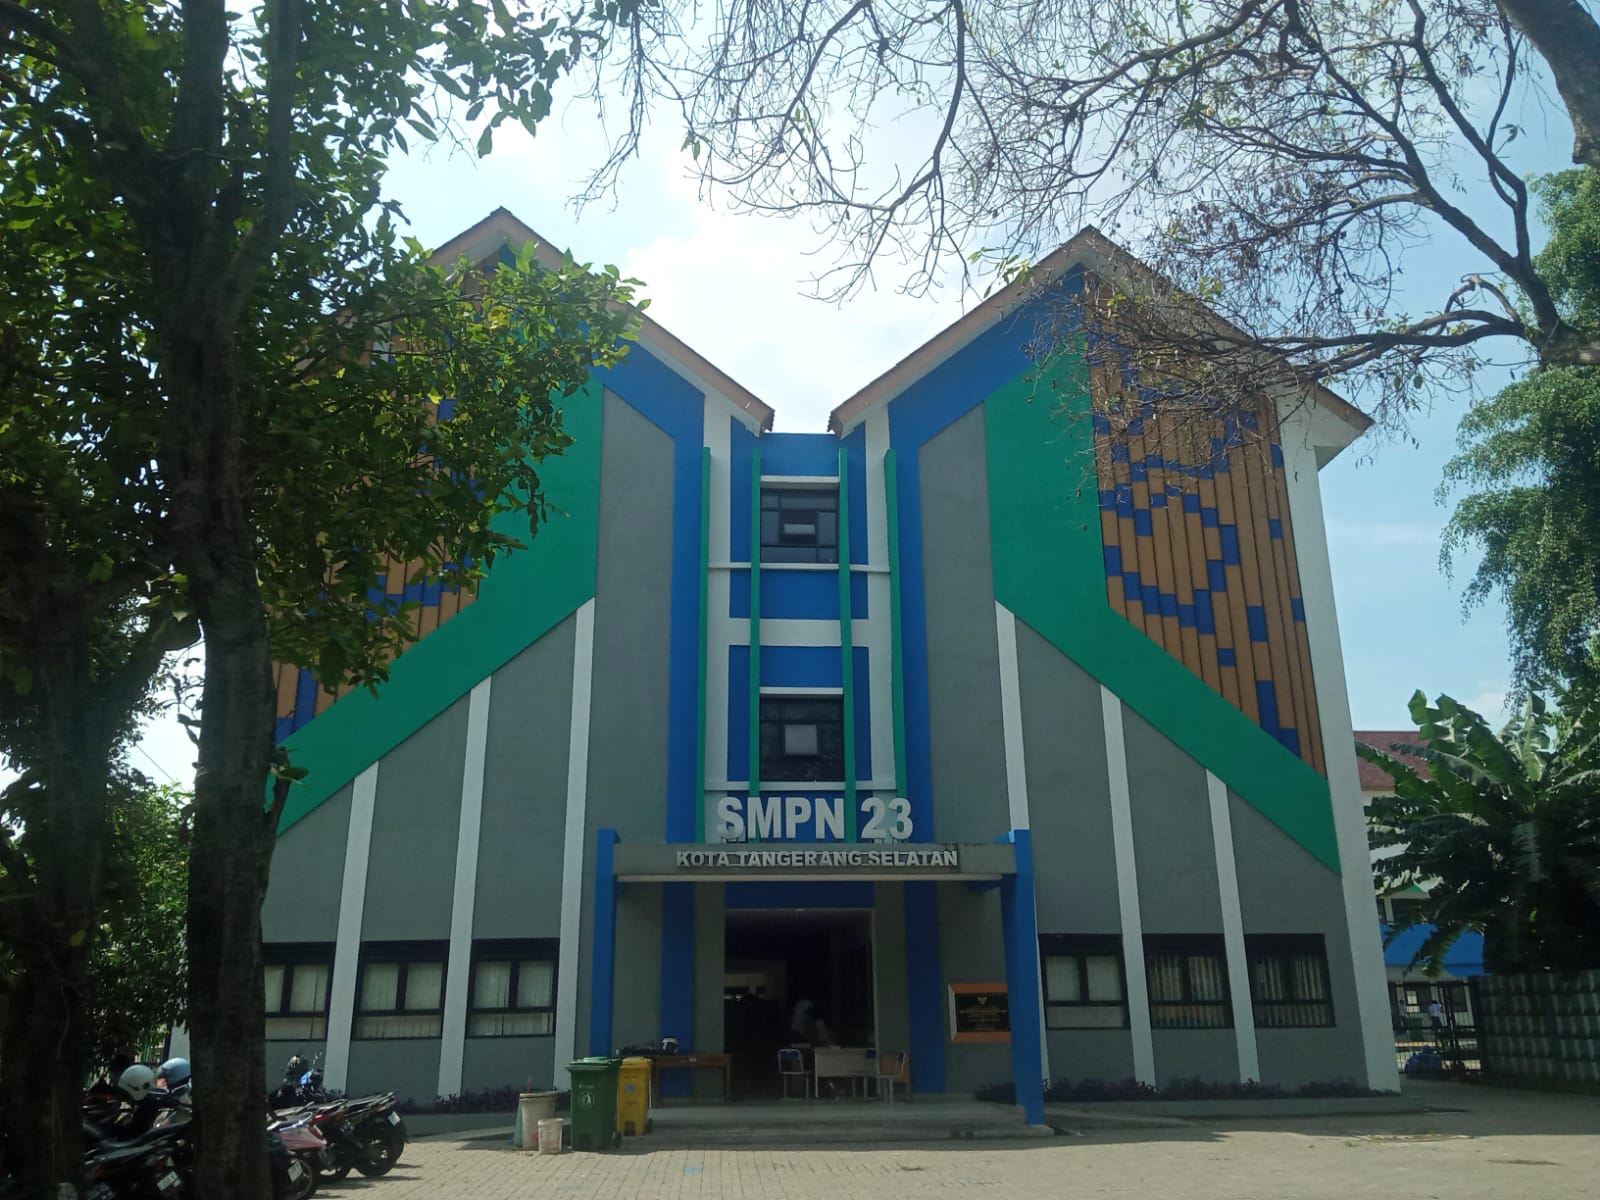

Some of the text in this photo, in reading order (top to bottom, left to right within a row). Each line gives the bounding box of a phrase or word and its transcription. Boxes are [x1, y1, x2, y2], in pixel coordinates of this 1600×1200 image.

[717, 796, 913, 840] SMPN 23
[676, 850, 958, 867] KOTA TANGERANG SELATAN
